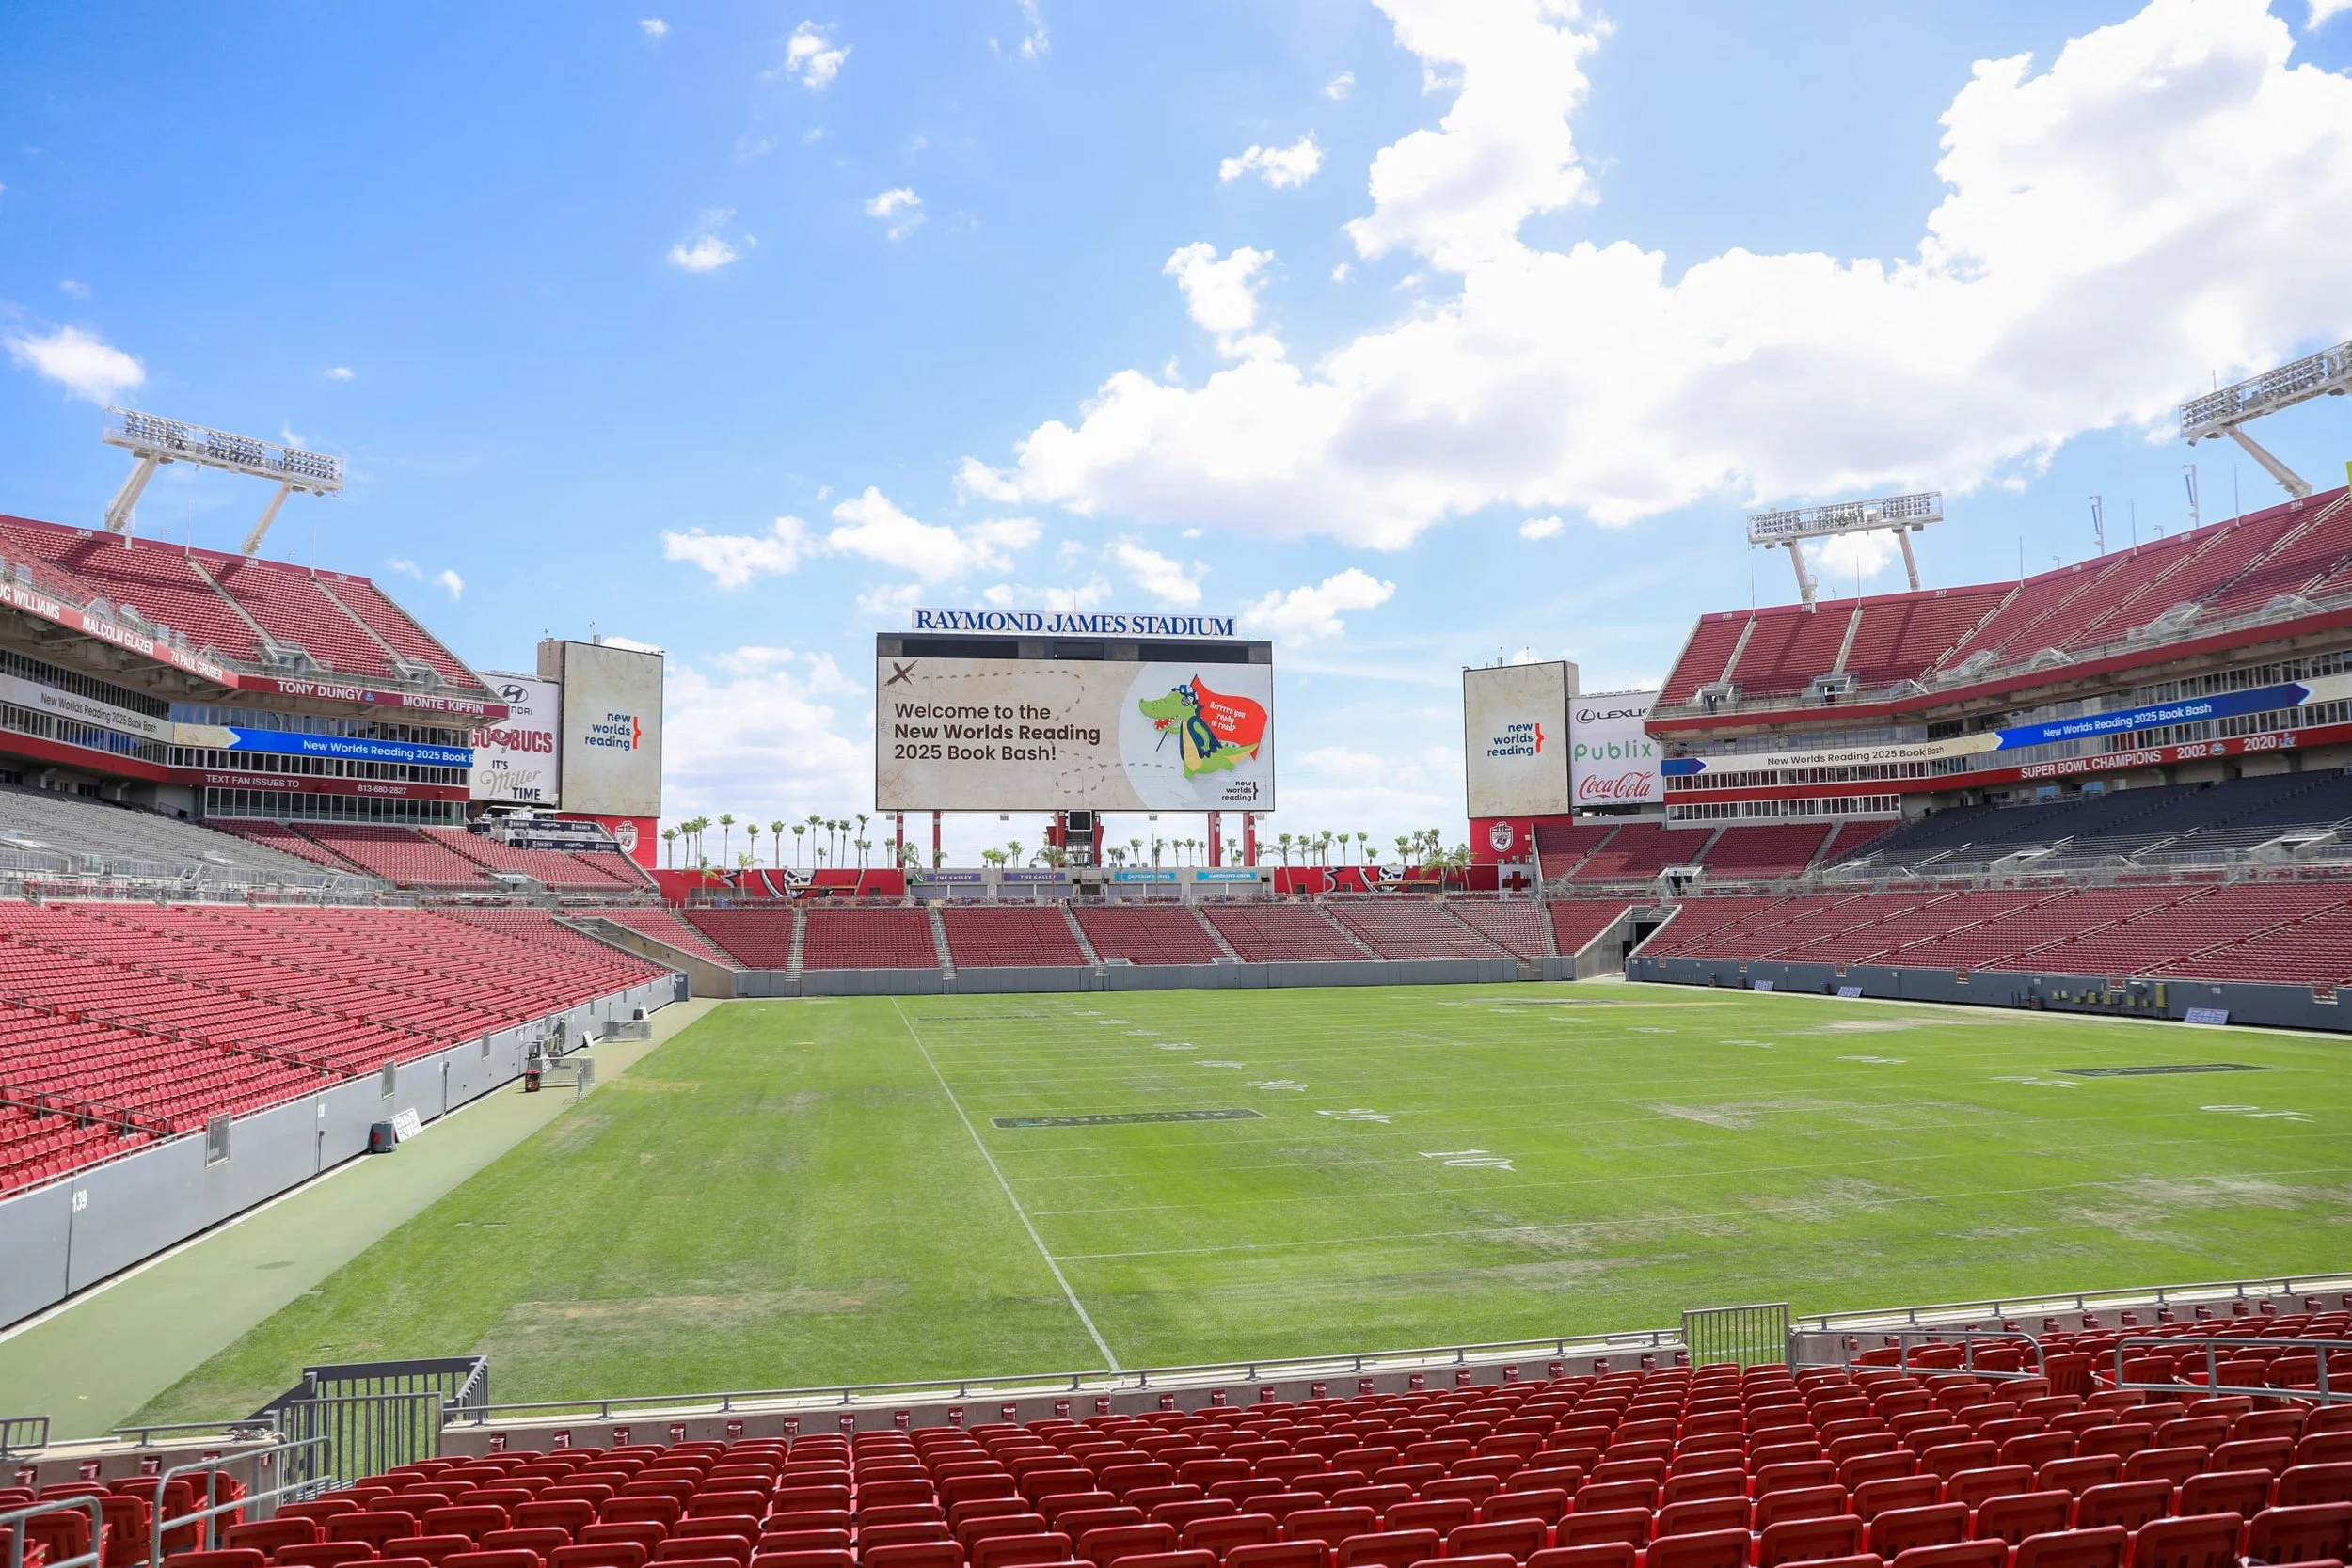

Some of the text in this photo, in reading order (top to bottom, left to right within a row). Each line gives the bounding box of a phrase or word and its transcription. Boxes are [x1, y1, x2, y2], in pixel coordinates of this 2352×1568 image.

[76, 529, 93, 537] 329
[245, 558, 259, 566] 328
[14, 588, 60, 620] WILLIAMS
[915, 610, 1234, 637] RAYMOND JAMES STADIUM
[82, 616, 154, 656] MALCOLM GLAZER
[170, 650, 224, 680] 74 PAUL GRUBER
[278, 681, 363, 701] TONY DUNGY
[40, 692, 158, 734] New Worlds Reading 2025 Book Bash
[403, 696, 484, 715] MONTE KIFFIN
[511, 705, 533, 715] NDAI
[895, 703, 1051, 721] Welcome to the
[607, 712, 631, 723] new
[1507, 722, 1533, 733] new
[2043, 703, 2212, 738] New Worlds Reading 2025 Book Bash
[592, 722, 631, 736] worlds
[895, 723, 1101, 746] New Worlds Reading
[1493, 733, 1534, 745] worlds
[303, 740, 327, 751] New
[330, 742, 369, 754] Worlds
[371, 745, 414, 761] Reading
[416, 750, 440, 760] 2025
[442, 753, 467, 762] Book
[511, 729, 553, 753] BUCS
[584, 735, 630, 752] reading
[1487, 745, 1534, 757] reading
[1574, 740, 1652, 761] Publix
[2177, 744, 2206, 760] 2002
[2243, 736, 2277, 752] 2020
[895, 744, 1057, 762] 2025 Book Bash!
[1768, 746, 1944, 767] New Worlds Reading 2025 Book Bash
[492, 759, 509, 770] IT'S
[2022, 750, 2162, 779] SUPER BOWL CHAMPIONS
[206, 775, 299, 788] TEXT FAN ISSUES TO
[358, 784, 407, 795] 813-680-2827
[480, 769, 542, 797] Miller
[1579, 771, 1655, 800] Coca-Cola
[512, 787, 541, 800] TIME
[72, 1189, 87, 1212] 139
